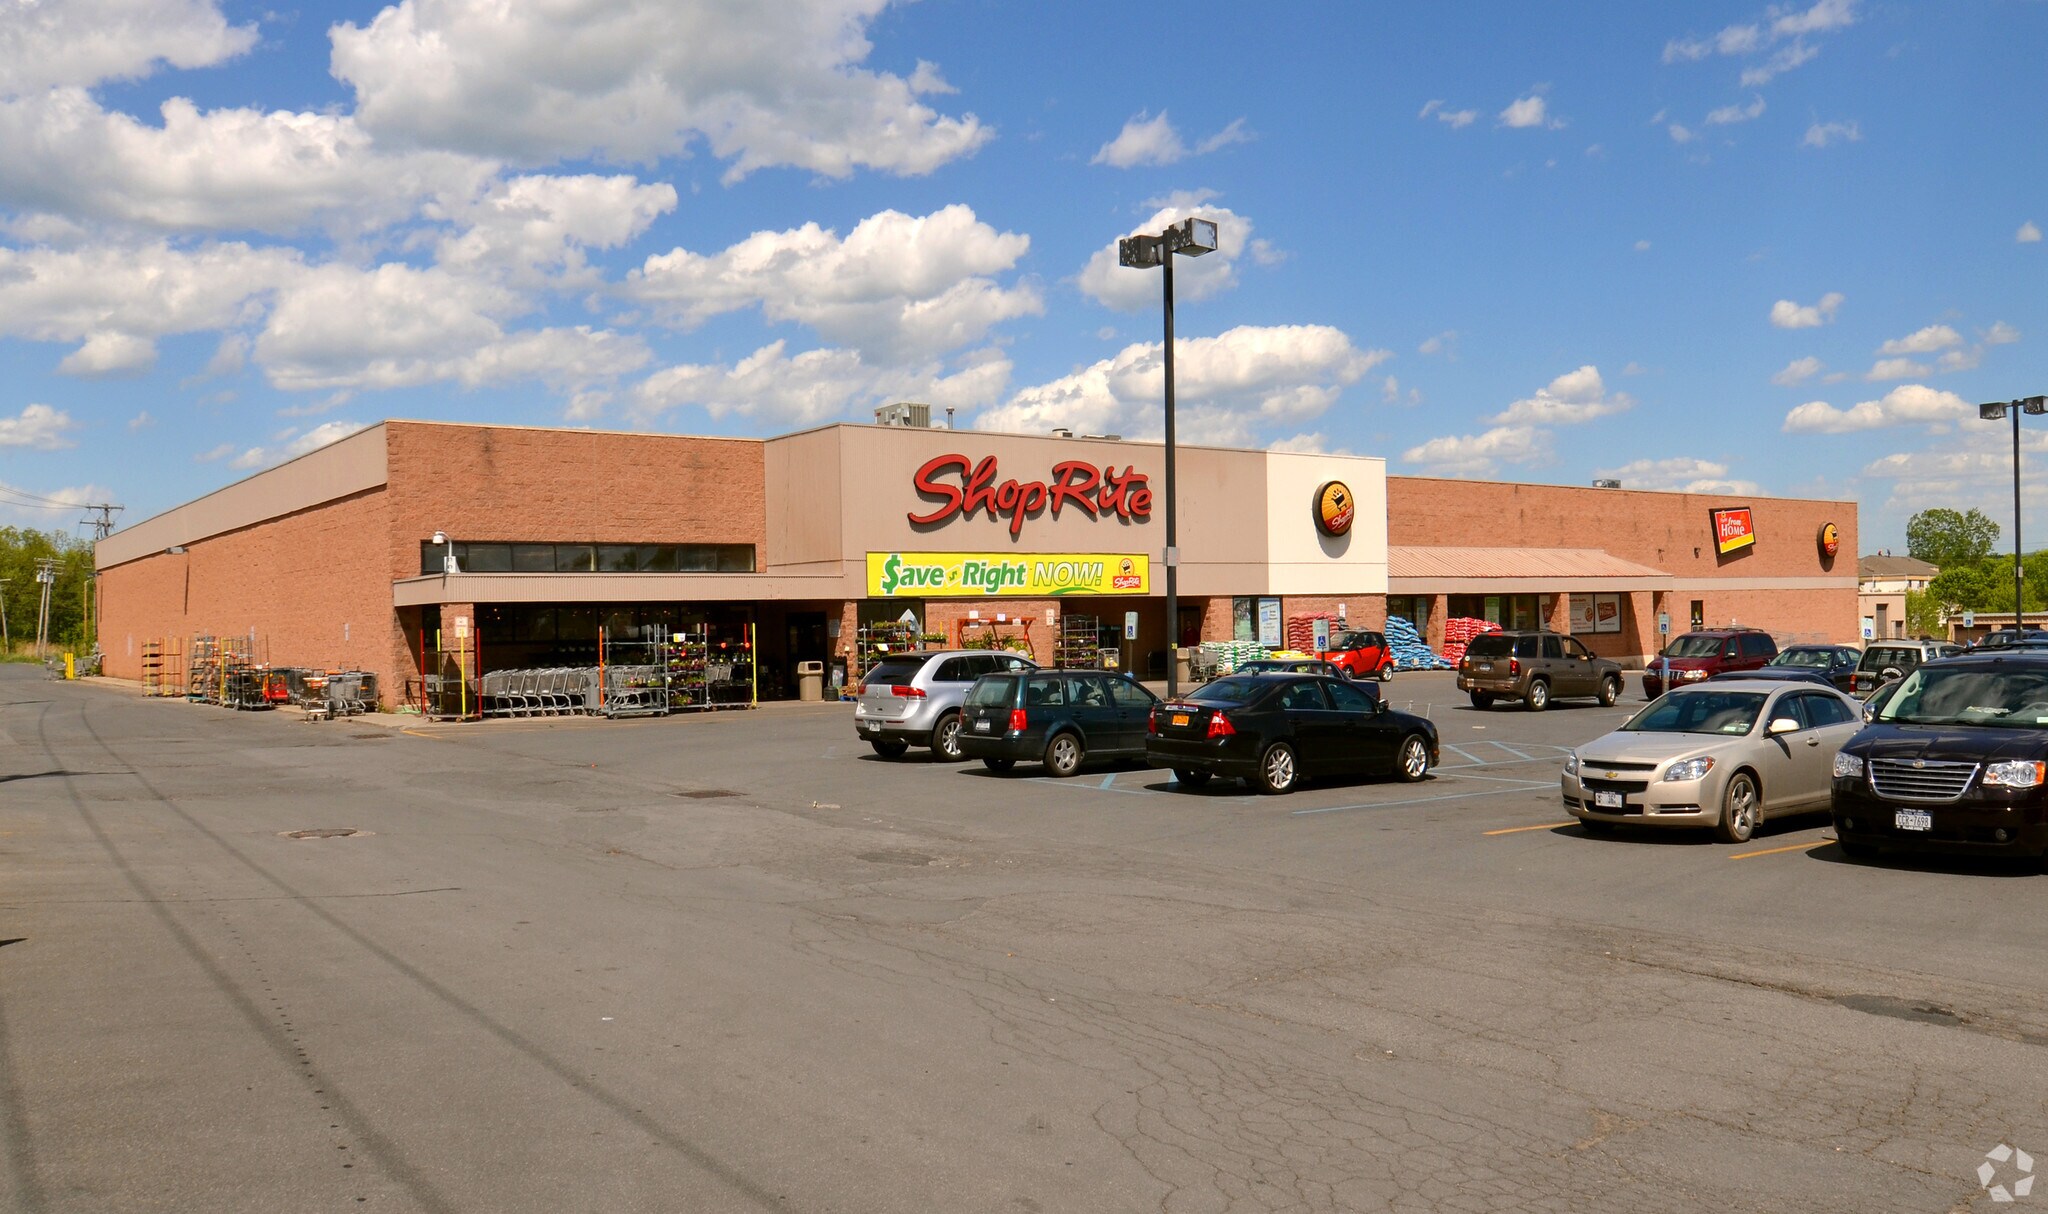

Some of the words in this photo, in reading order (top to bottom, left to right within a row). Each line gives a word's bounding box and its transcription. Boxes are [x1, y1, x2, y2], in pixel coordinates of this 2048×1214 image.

[907, 454, 1152, 534] ShopRite
[962, 561, 1026, 592] Right
[1033, 561, 1104, 587] NOW!
